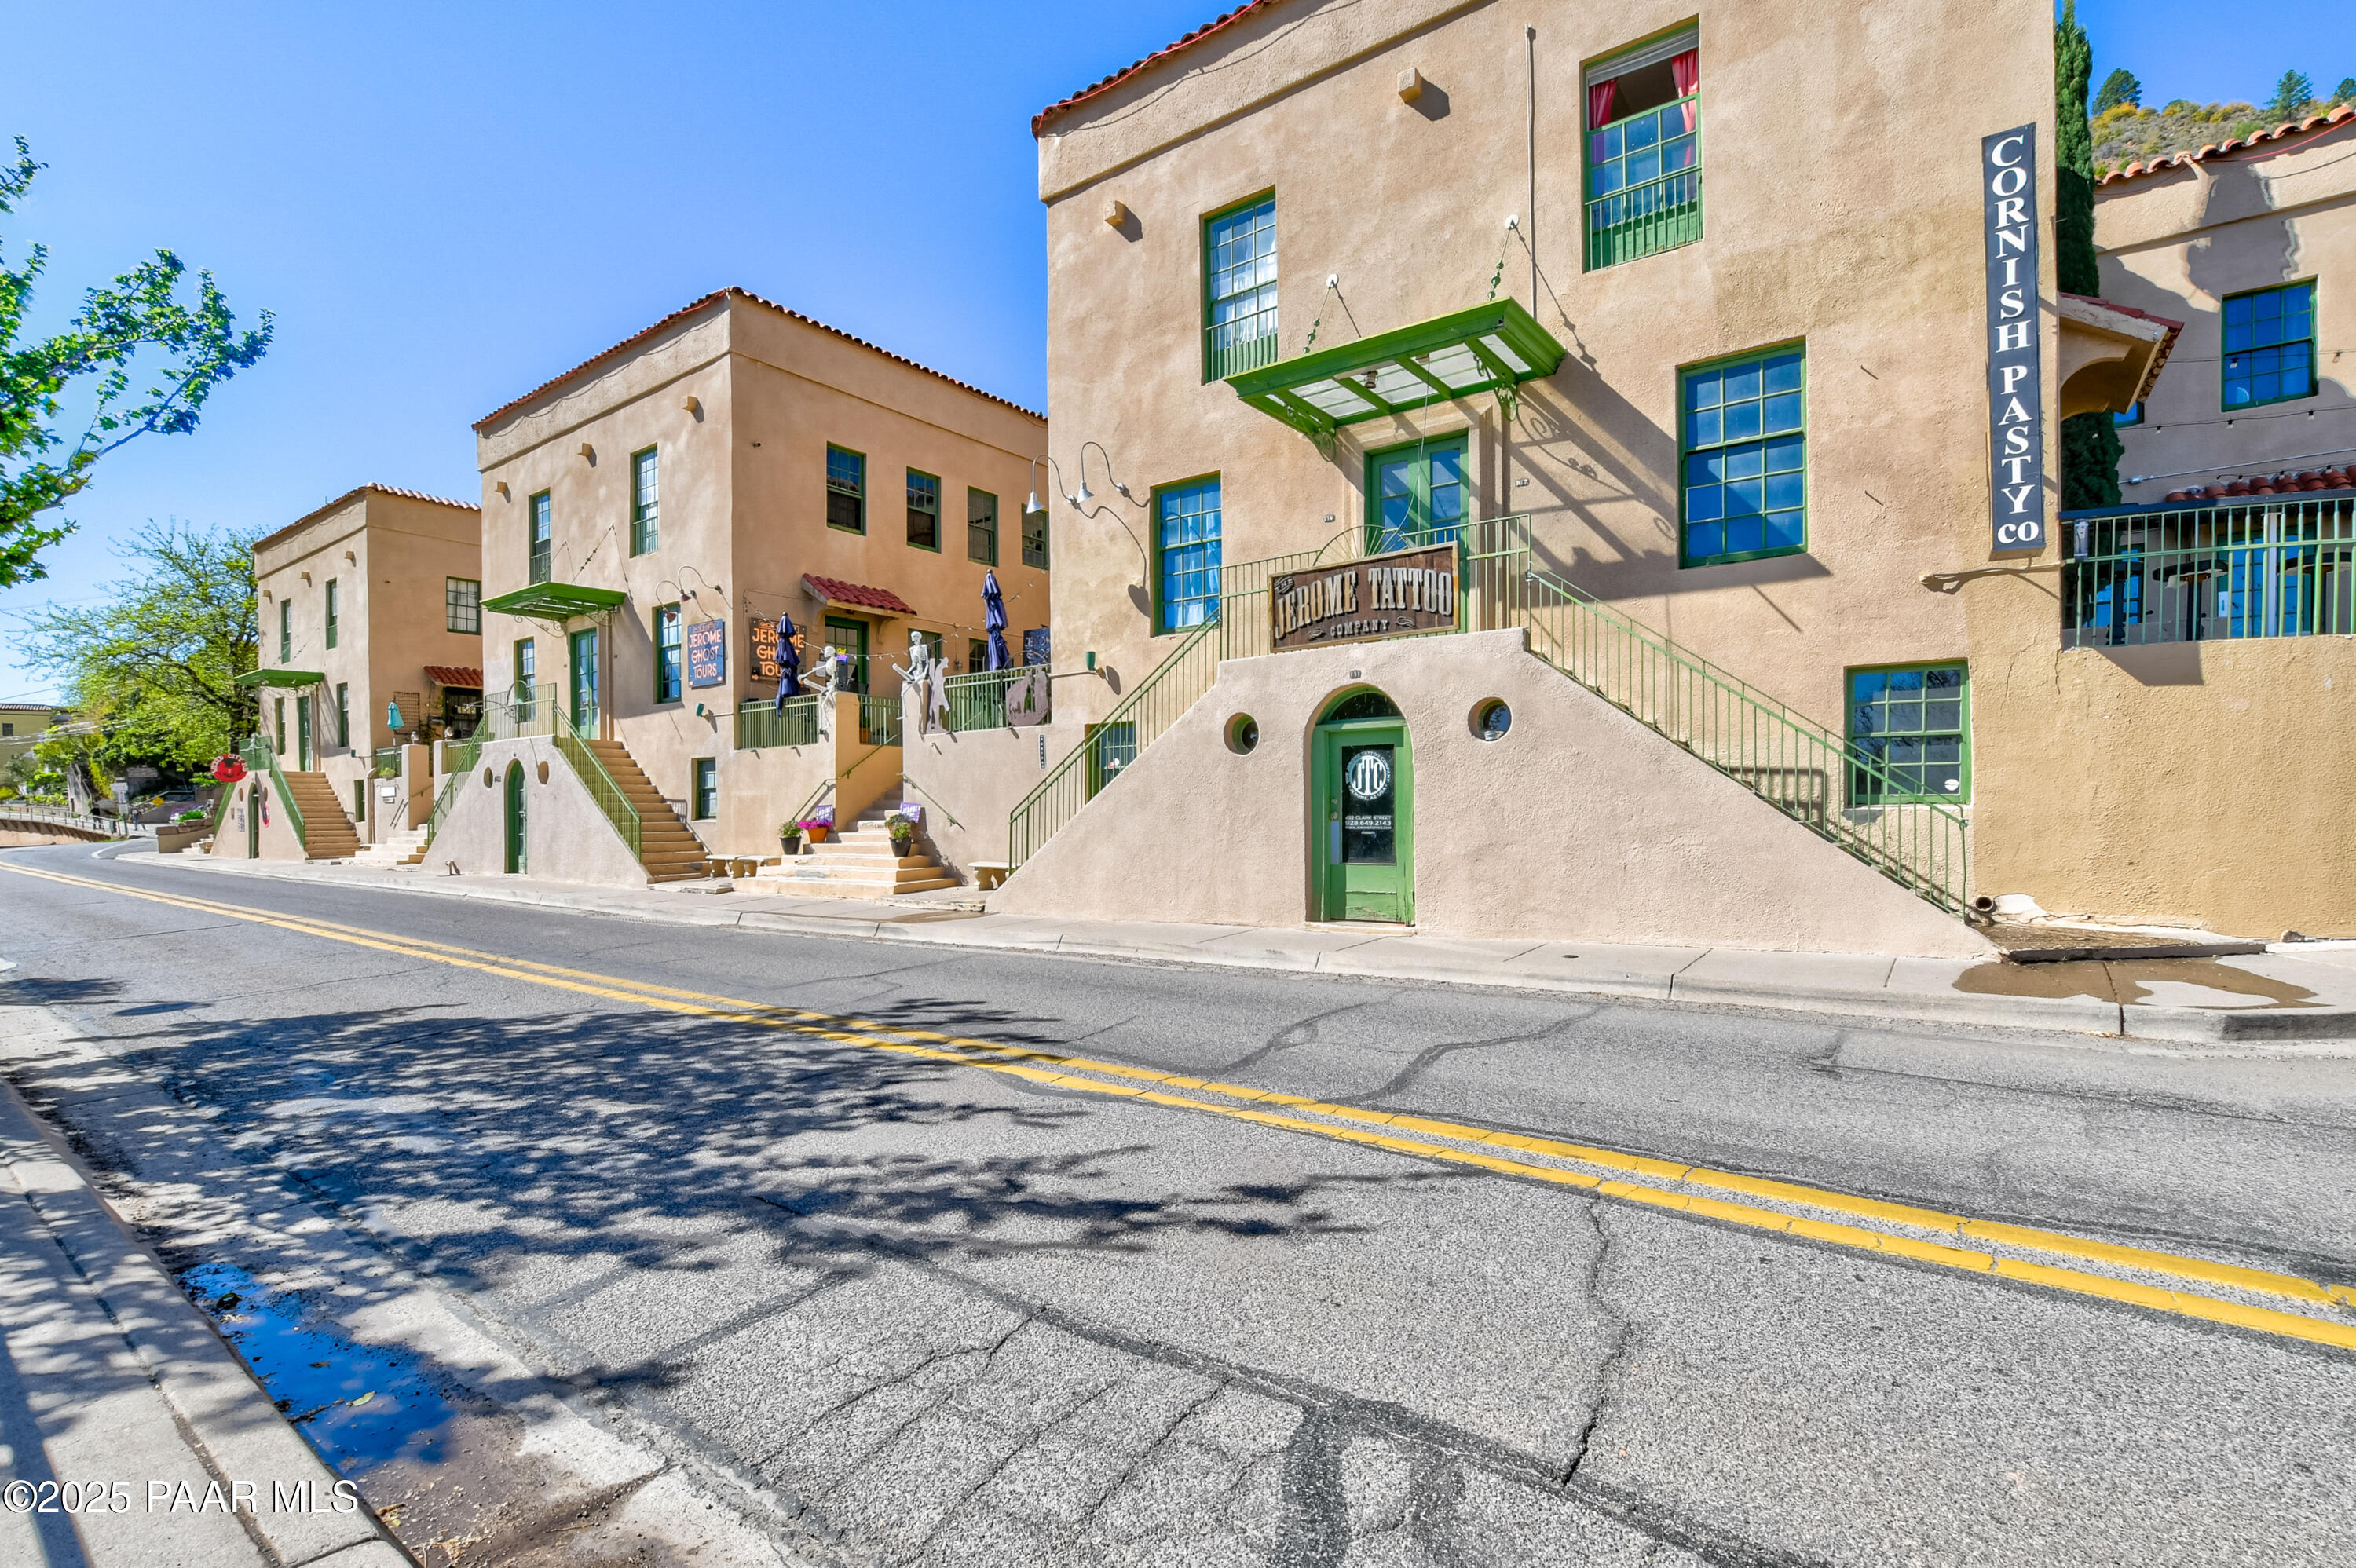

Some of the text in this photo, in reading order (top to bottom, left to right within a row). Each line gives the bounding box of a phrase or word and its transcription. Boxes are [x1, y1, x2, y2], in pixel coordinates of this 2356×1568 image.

[1991, 134, 2032, 353] CORNISH
[1997, 365, 2036, 514] PASTY
[1275, 567, 1453, 641] JEROME TATTOO
[689, 628, 722, 648] JEROME
[752, 628, 805, 649] JERME
[1330, 620, 1389, 637] COMPANY
[691, 645, 719, 664] GHOST
[756, 645, 800, 660] GHT
[693, 663, 718, 679] TOURS
[1380, 756, 1391, 783] COMPANY
[1377, 787, 1387, 796] USA
